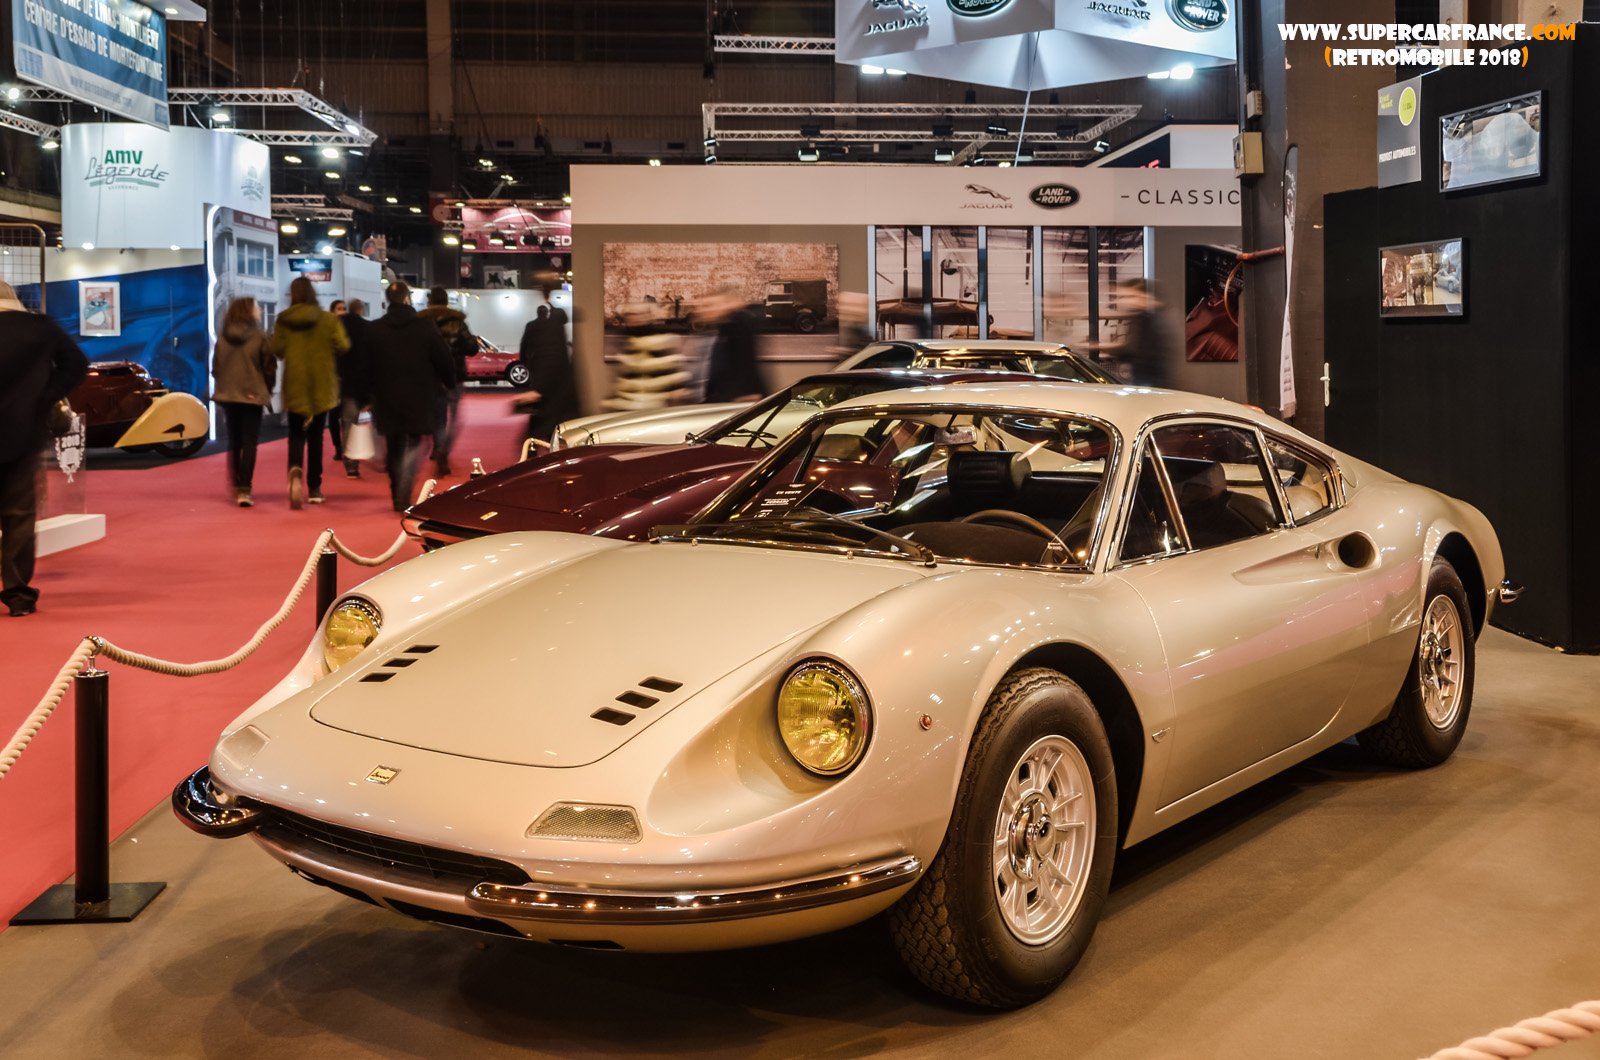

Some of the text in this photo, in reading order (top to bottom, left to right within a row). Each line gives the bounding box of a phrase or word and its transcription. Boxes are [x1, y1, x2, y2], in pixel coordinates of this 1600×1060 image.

[24, 0, 58, 35] CENTRE
[60, 16, 97, 52] D'ESSAIS
[97, 35, 109, 58] DE
[864, 16, 930, 36] JAGUAR
[104, 150, 143, 164] AMV
[1038, 188, 1064, 196] LAND
[1041, 195, 1073, 204] ROVER
[1137, 189, 1241, 205] CLASSIC
